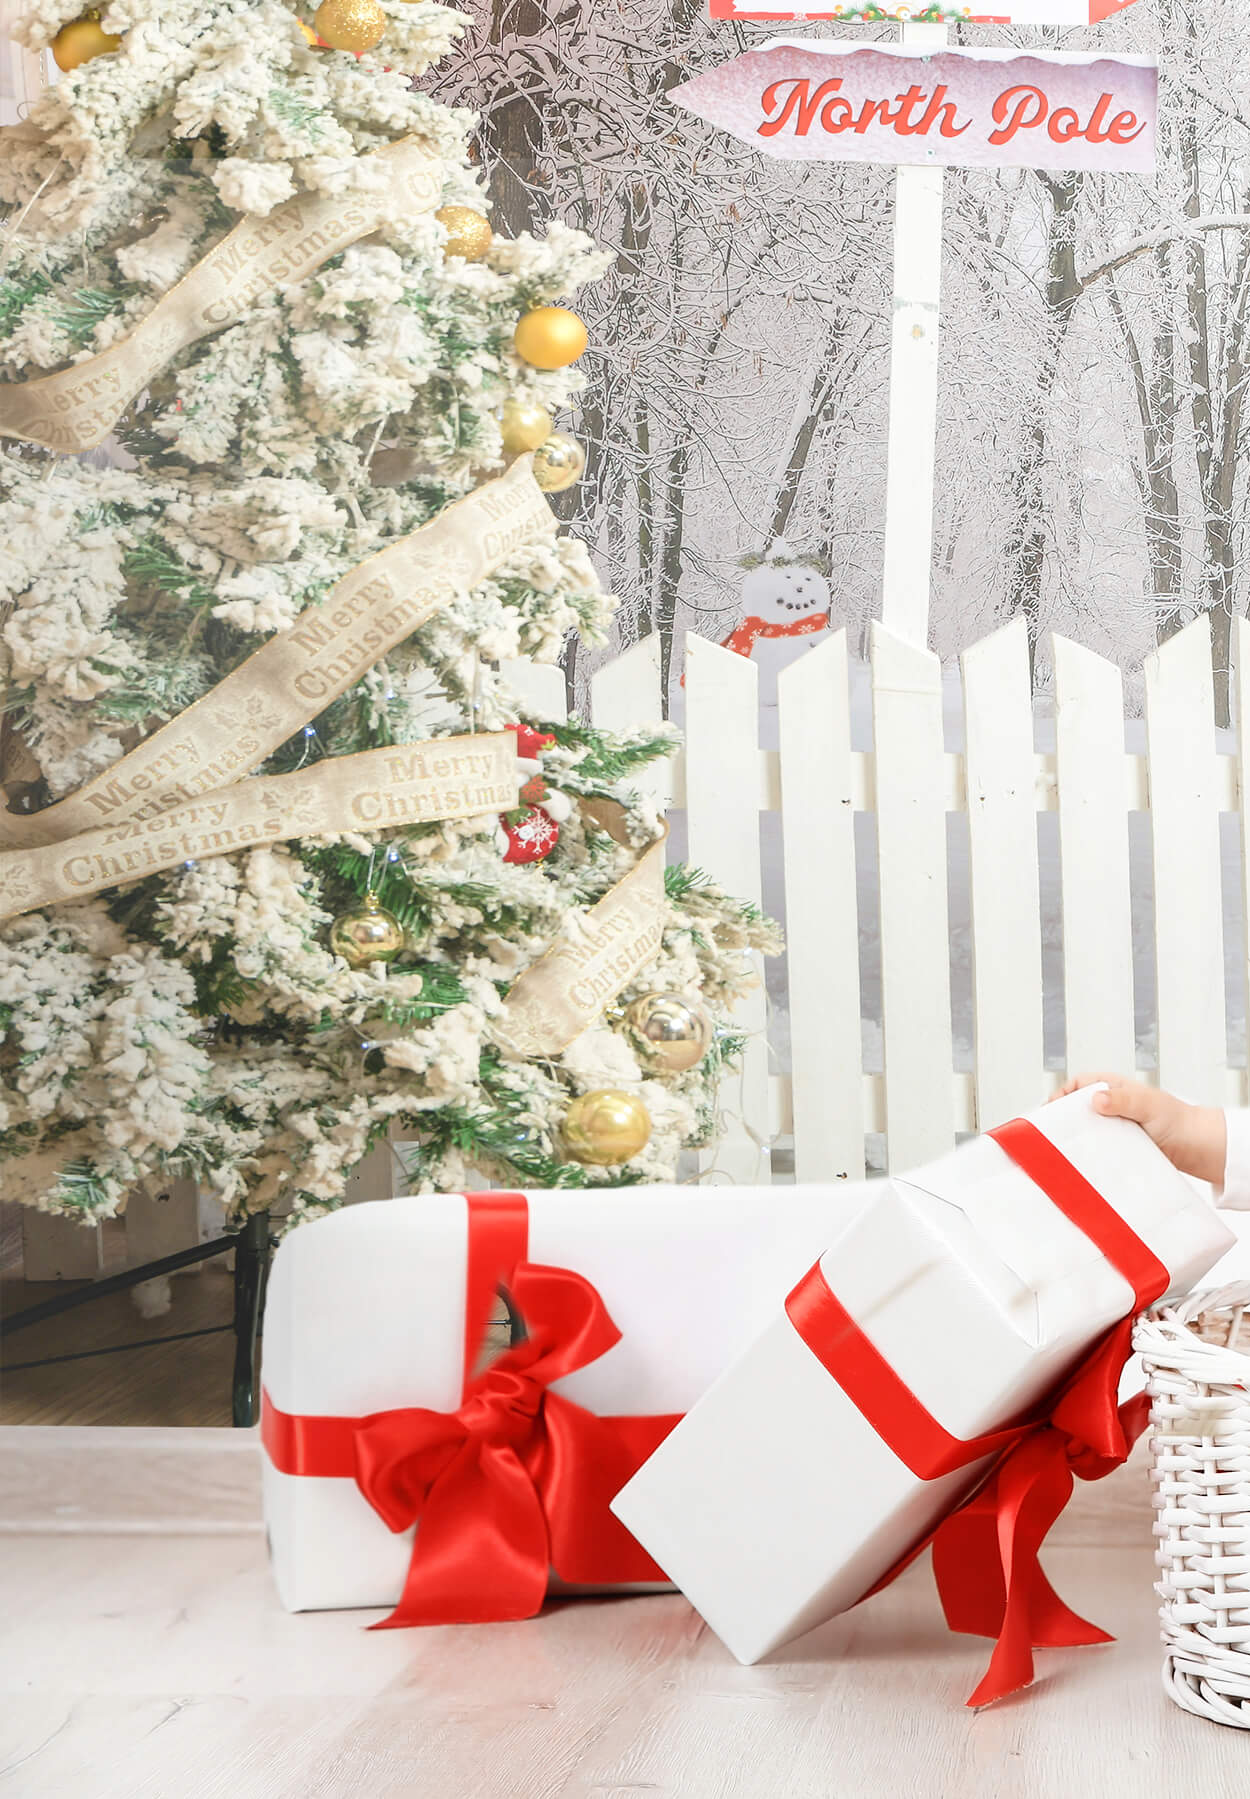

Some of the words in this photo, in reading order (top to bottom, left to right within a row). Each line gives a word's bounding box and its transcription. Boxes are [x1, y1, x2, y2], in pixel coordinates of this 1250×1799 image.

[757, 78, 973, 138] North
[988, 84, 1147, 146] Pole
[211, 203, 305, 285] Merry
[288, 574, 395, 656] Merry
[85, 736, 200, 815] Merry
[352, 783, 513, 822] Christmas
[384, 752, 493, 783] Merry
[63, 817, 284, 887] Christmas
